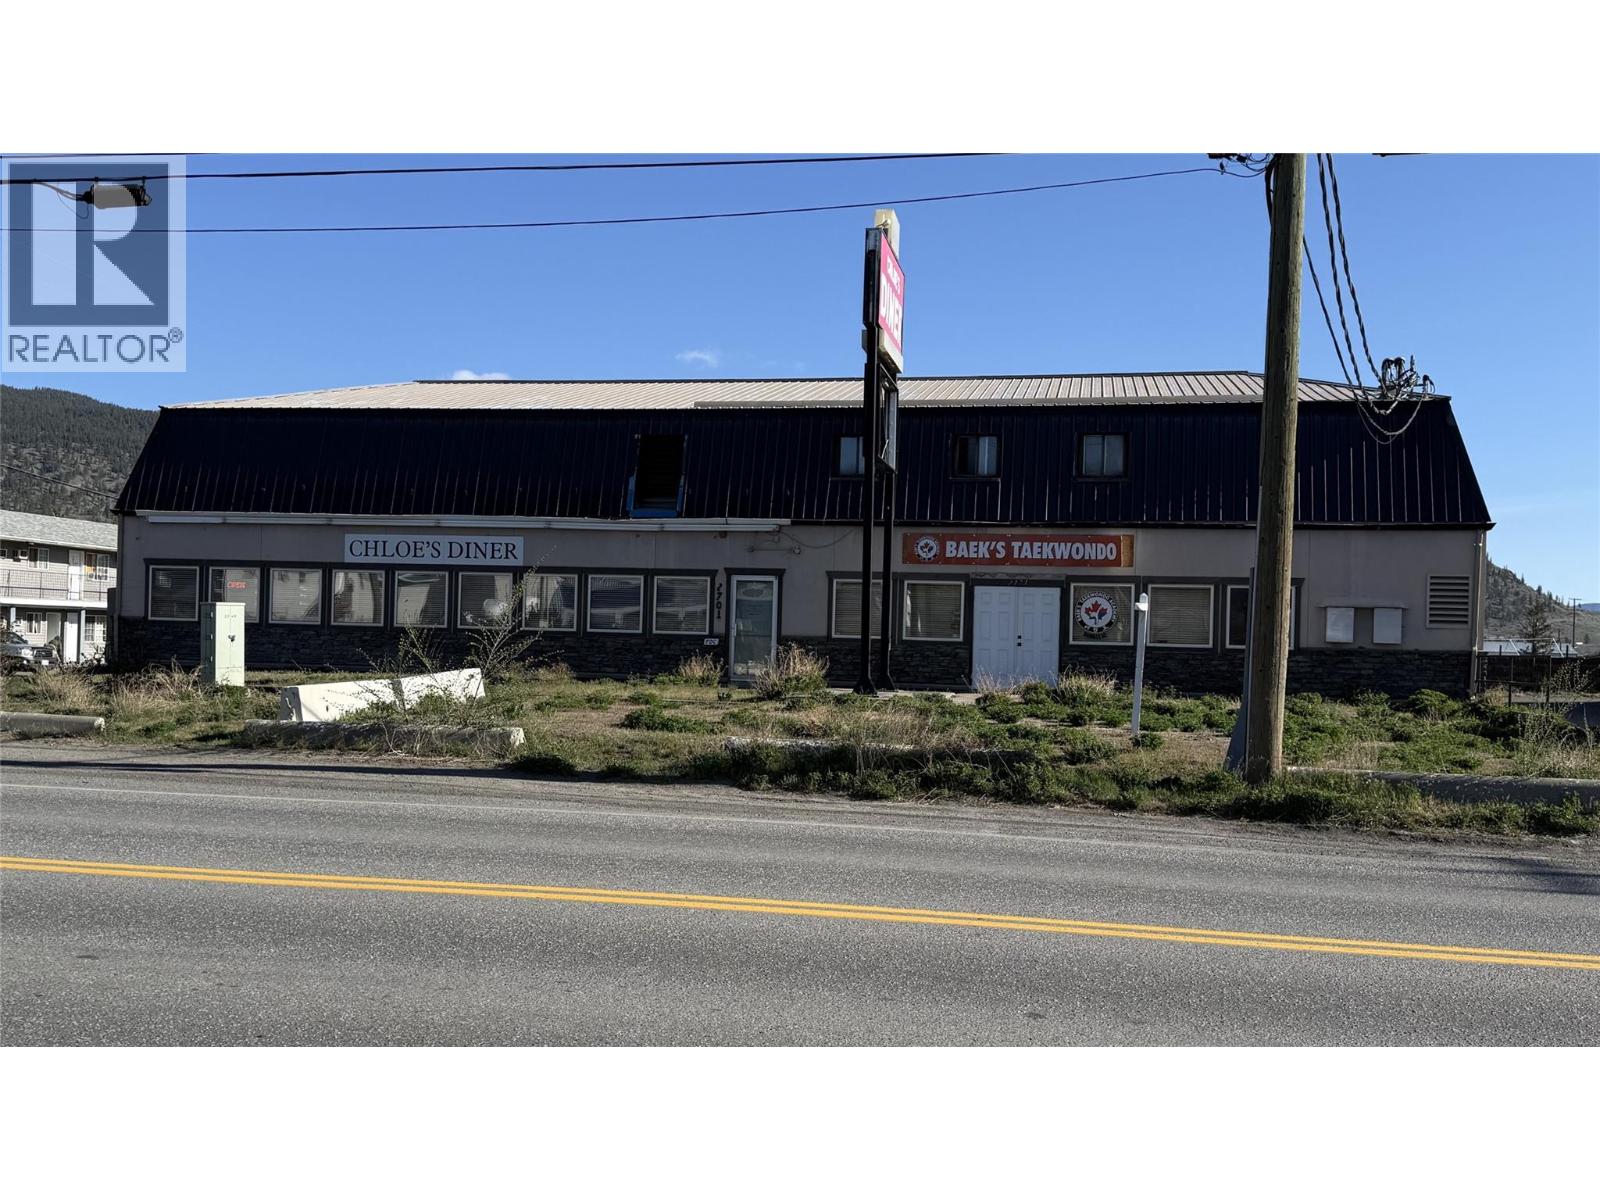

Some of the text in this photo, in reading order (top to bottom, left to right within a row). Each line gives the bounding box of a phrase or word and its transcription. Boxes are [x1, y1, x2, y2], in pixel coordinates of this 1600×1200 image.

[349, 540, 518, 560] CHLOE'S DINER
[945, 540, 1006, 559] BAEK'S
[1011, 542, 1117, 560] TAEKWONDO
